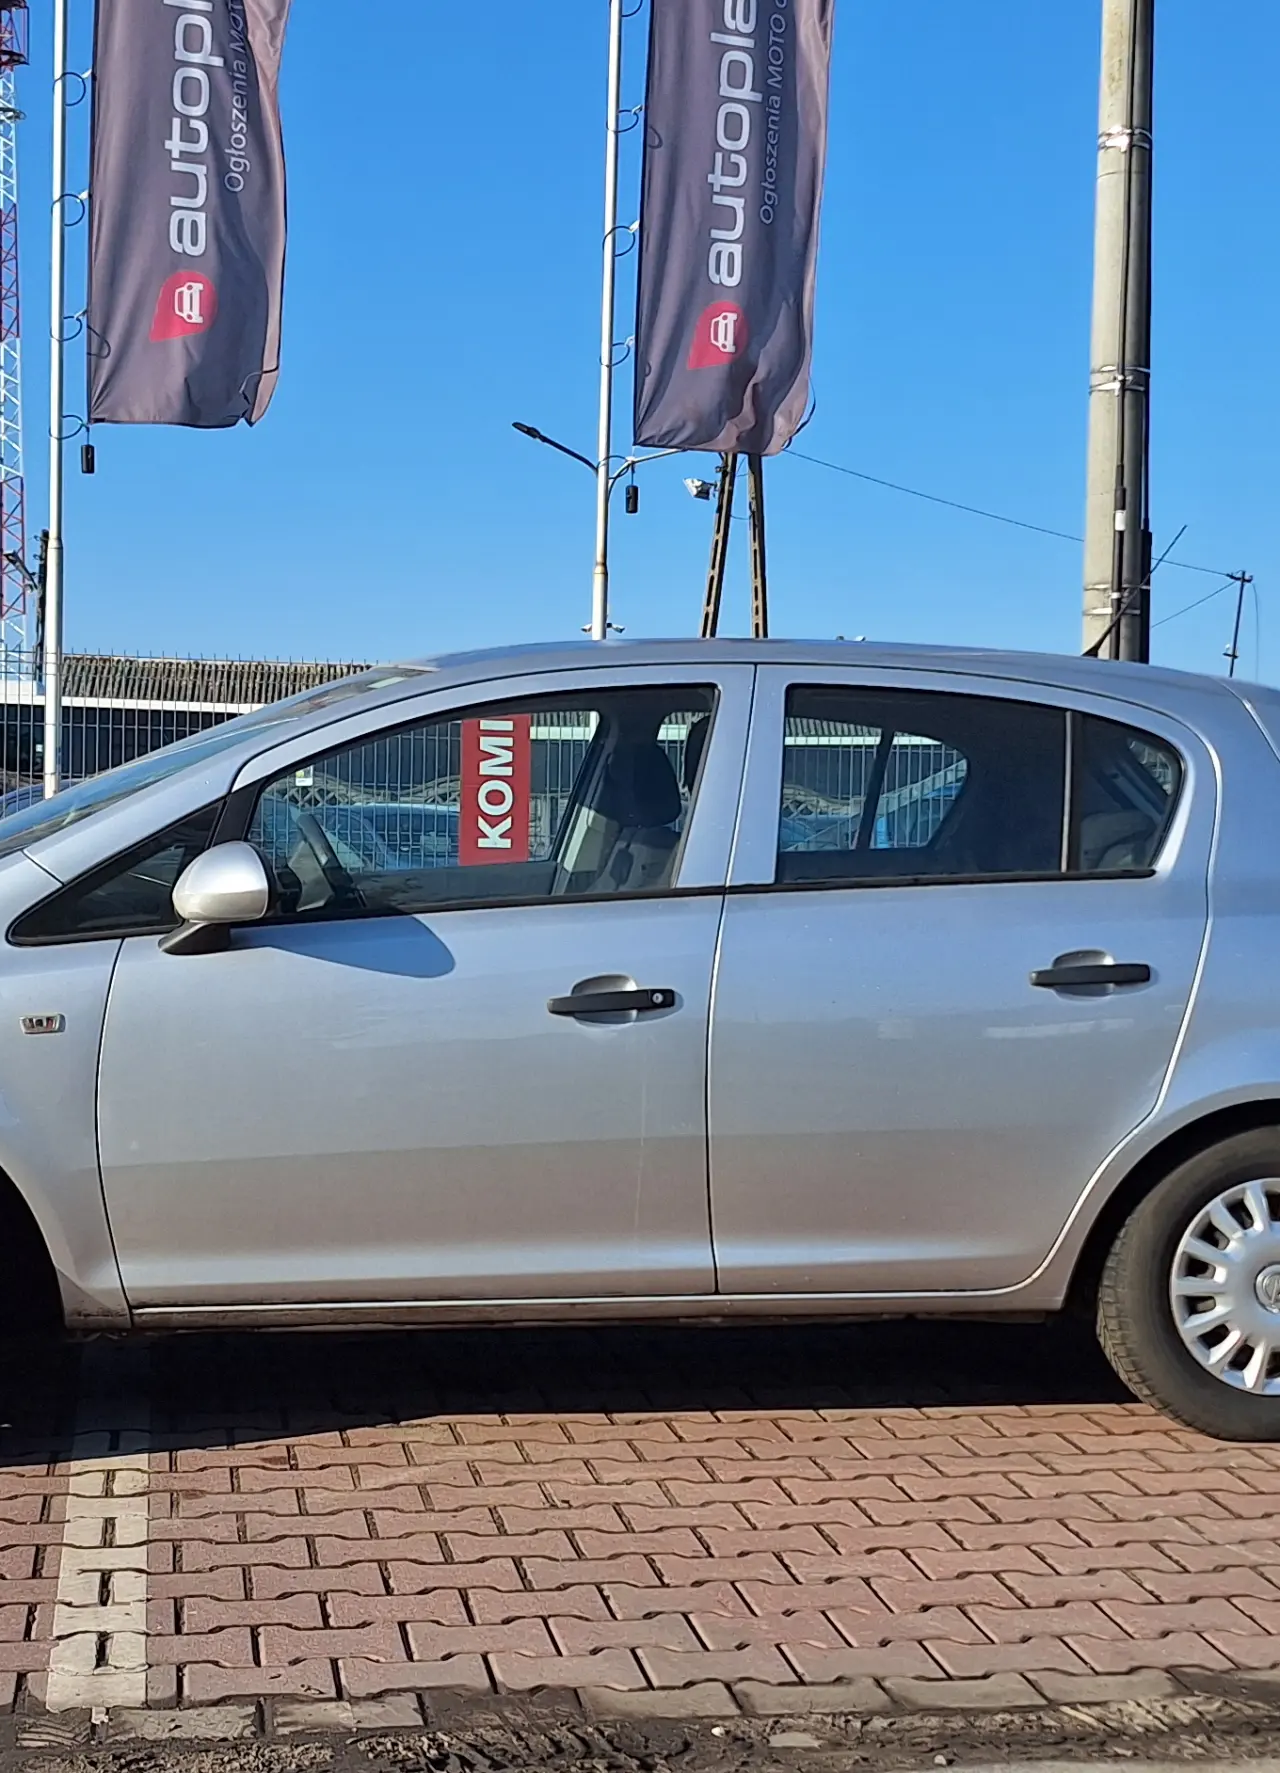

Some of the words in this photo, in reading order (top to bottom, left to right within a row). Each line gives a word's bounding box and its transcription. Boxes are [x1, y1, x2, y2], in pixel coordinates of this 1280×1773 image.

[766, 13, 787, 93] MOTO
[224, 58, 251, 193] Ogłoszenia
[707, 0, 763, 287] autopla
[759, 95, 782, 225] Ogłoszenia
[477, 719, 514, 849] KOMI
